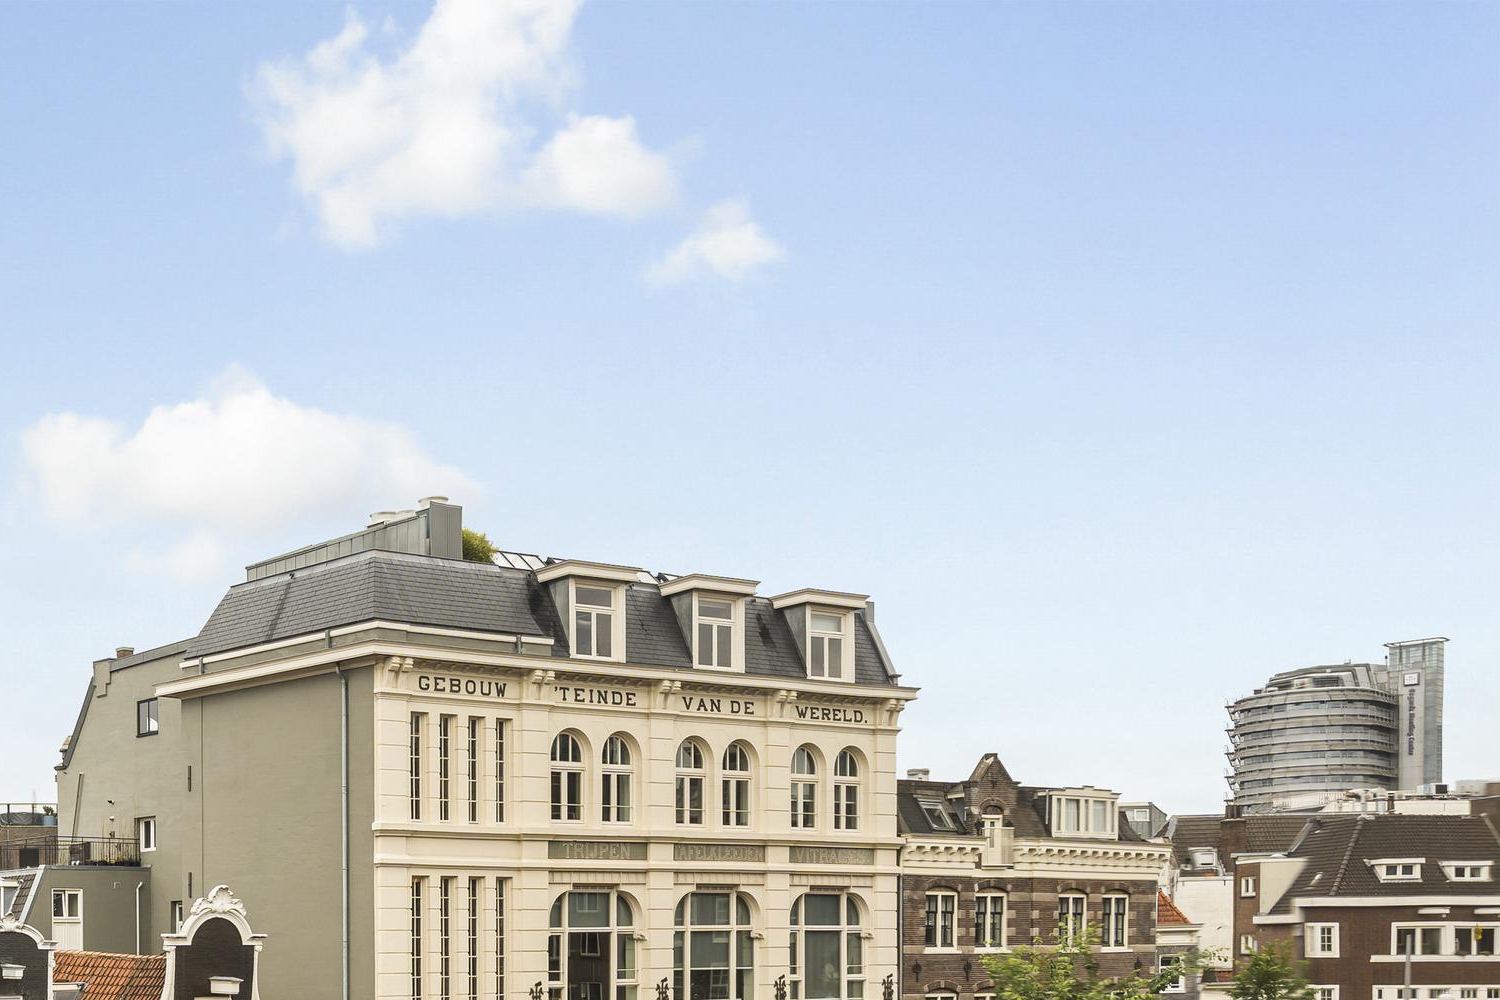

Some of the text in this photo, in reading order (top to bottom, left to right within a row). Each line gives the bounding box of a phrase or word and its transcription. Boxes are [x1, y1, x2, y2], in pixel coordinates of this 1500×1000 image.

[418, 675, 507, 697] GEBOUW
[682, 696, 722, 712] VAN
[730, 700, 755, 715] DE
[795, 705, 868, 723] WERELD.
